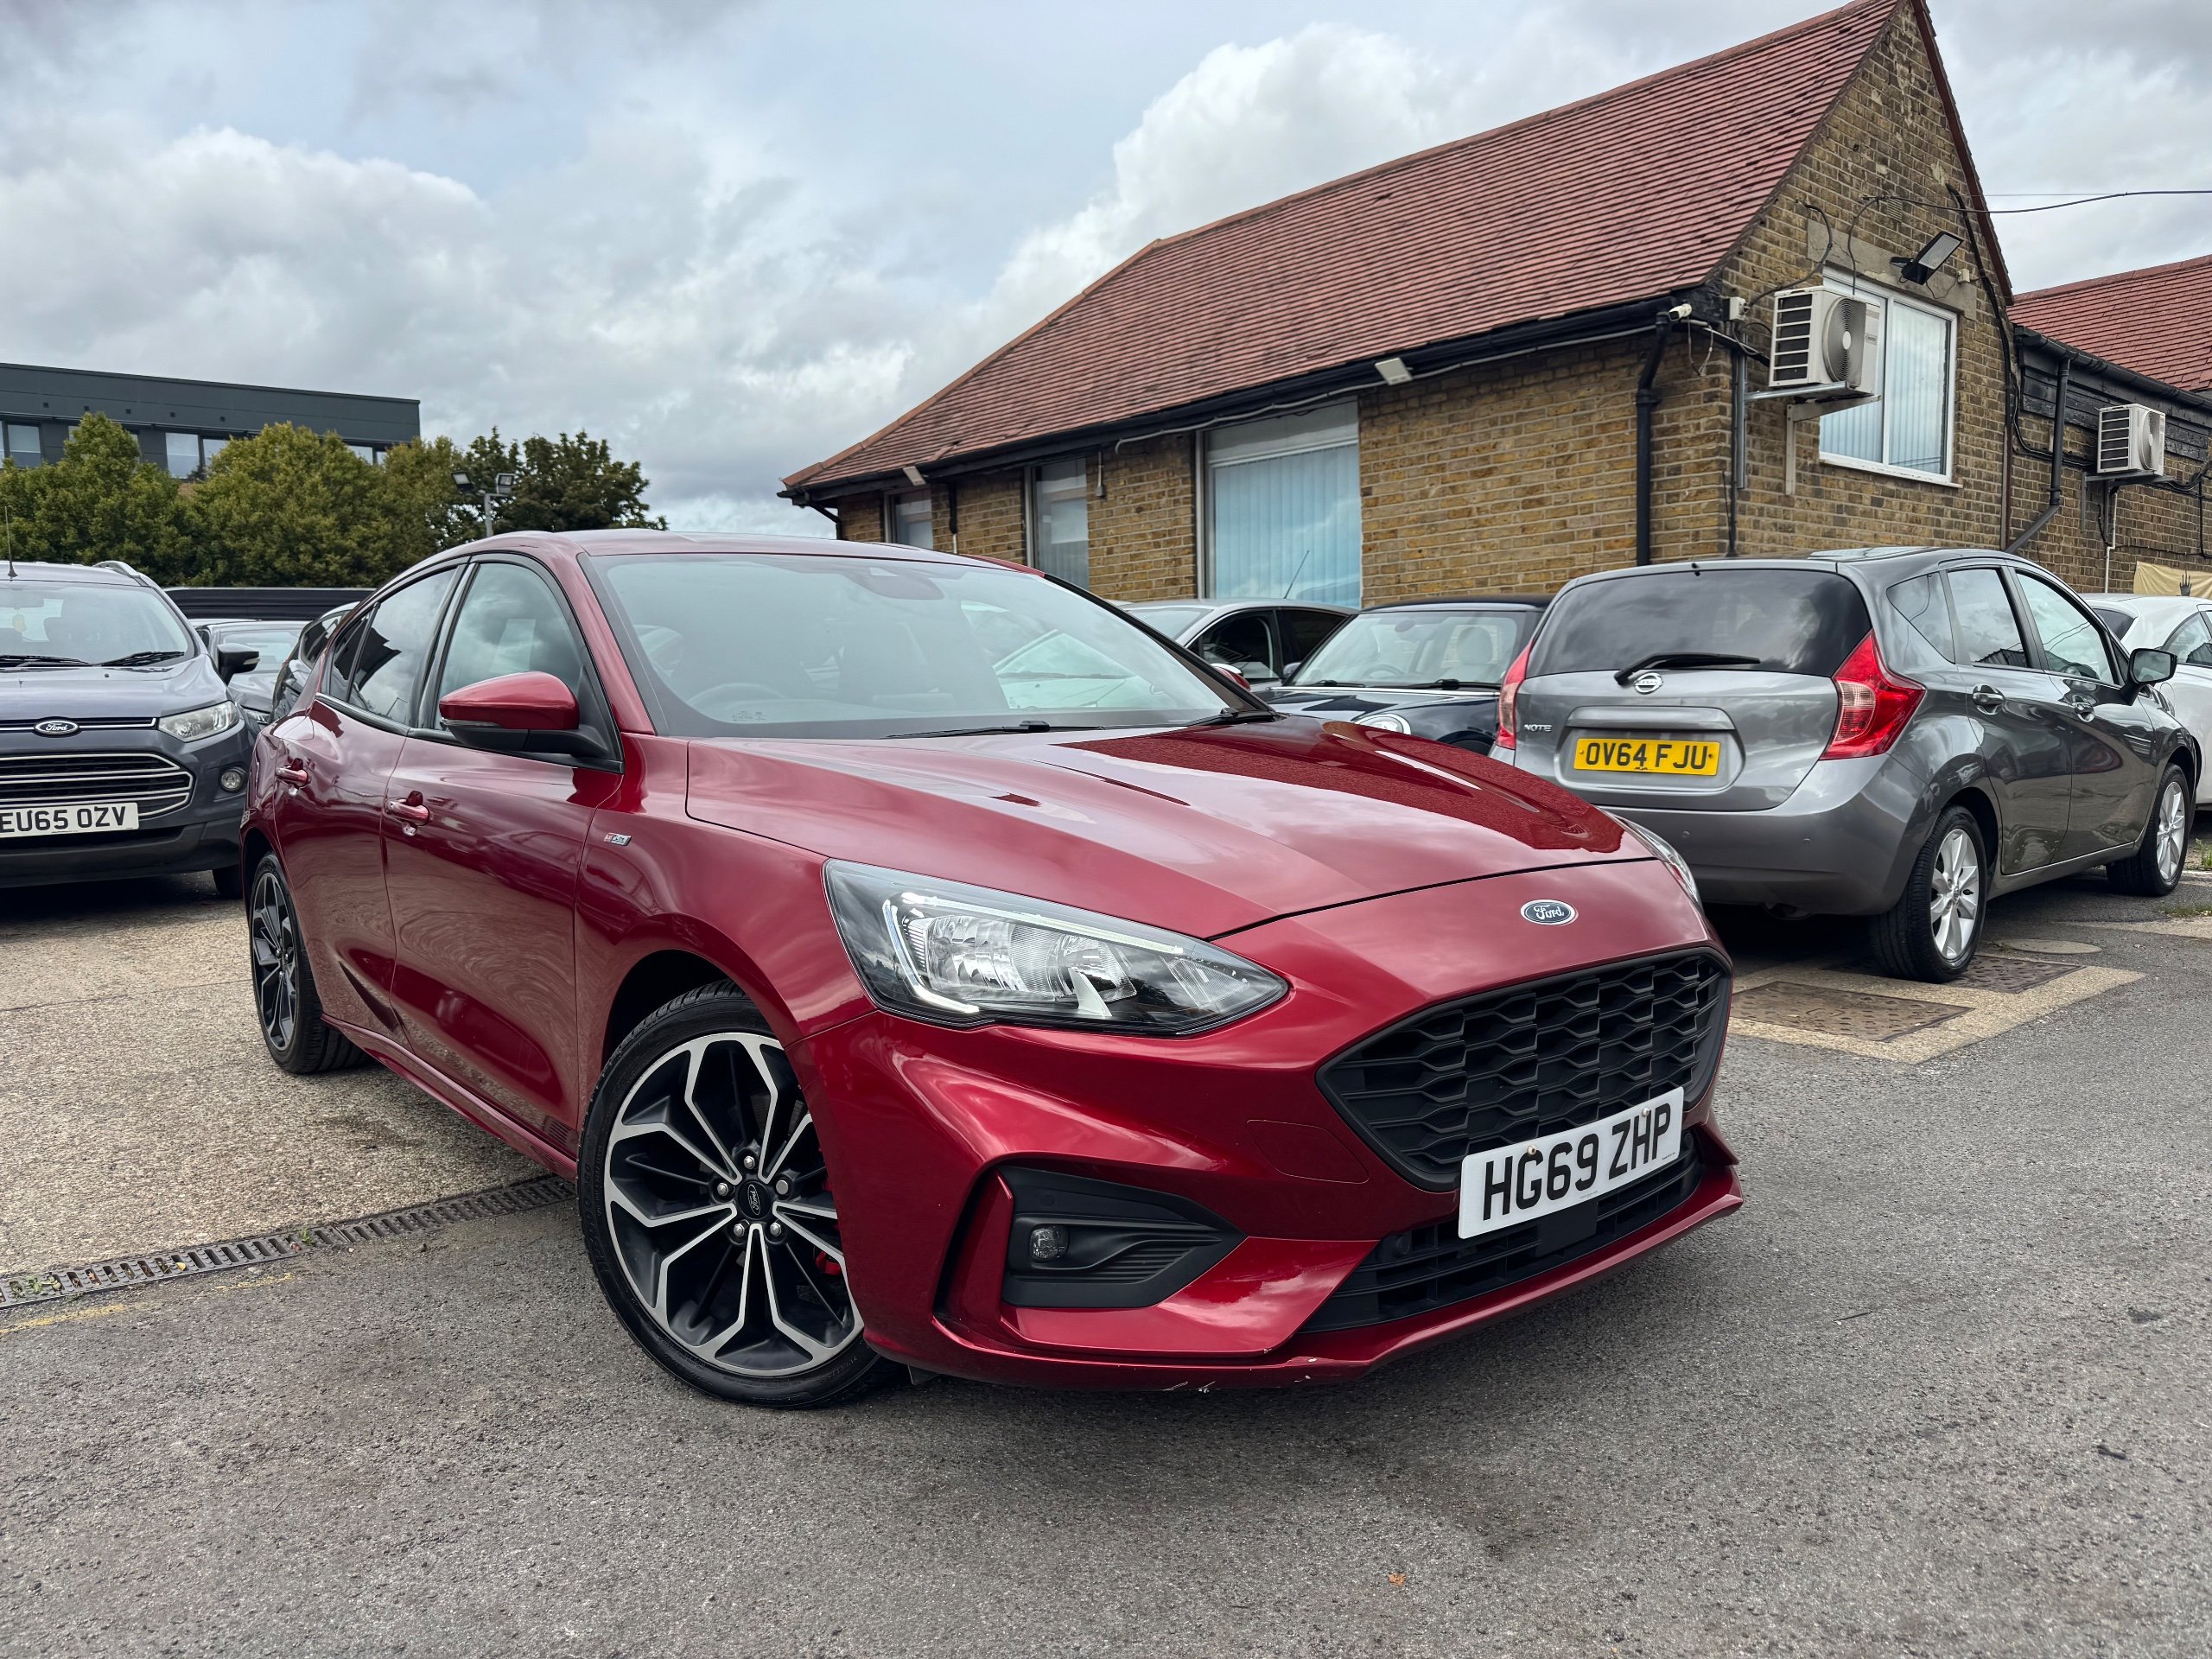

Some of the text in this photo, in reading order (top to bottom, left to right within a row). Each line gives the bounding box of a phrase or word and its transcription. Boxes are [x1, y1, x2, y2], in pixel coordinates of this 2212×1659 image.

[1586, 742, 1647, 766] OV64
[0, 806, 125, 833] EU65 OZV
[1533, 905, 1565, 919] Ford
[1483, 1103, 1670, 1221] HG69 ZHP
